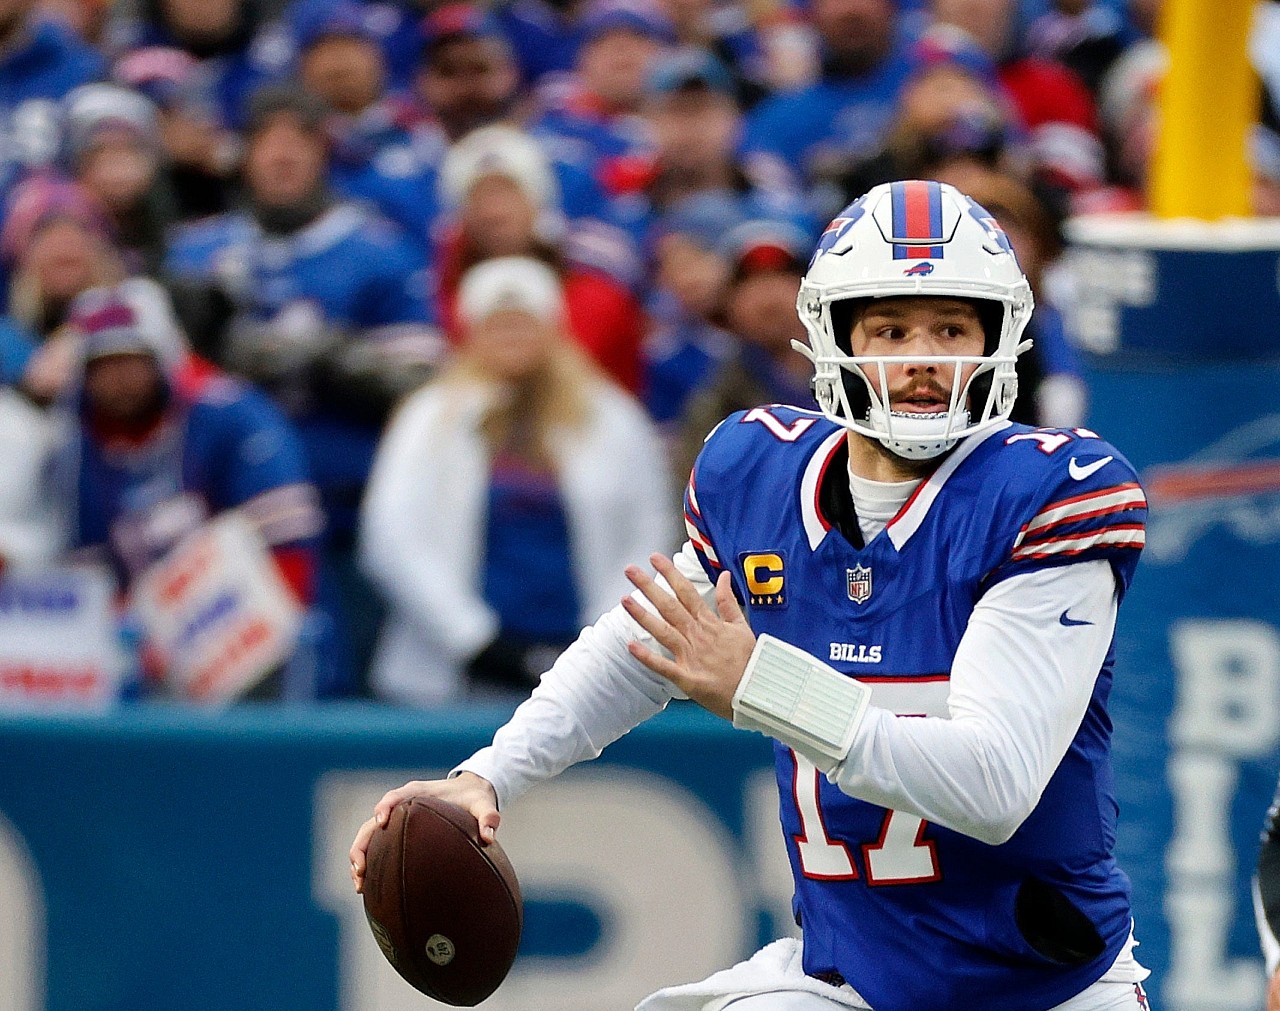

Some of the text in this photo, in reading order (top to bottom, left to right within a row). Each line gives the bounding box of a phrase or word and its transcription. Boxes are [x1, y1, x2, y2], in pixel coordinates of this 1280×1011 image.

[743, 554, 785, 595] C
[850, 581, 869, 598] NFL
[829, 642, 882, 663] BILLS
